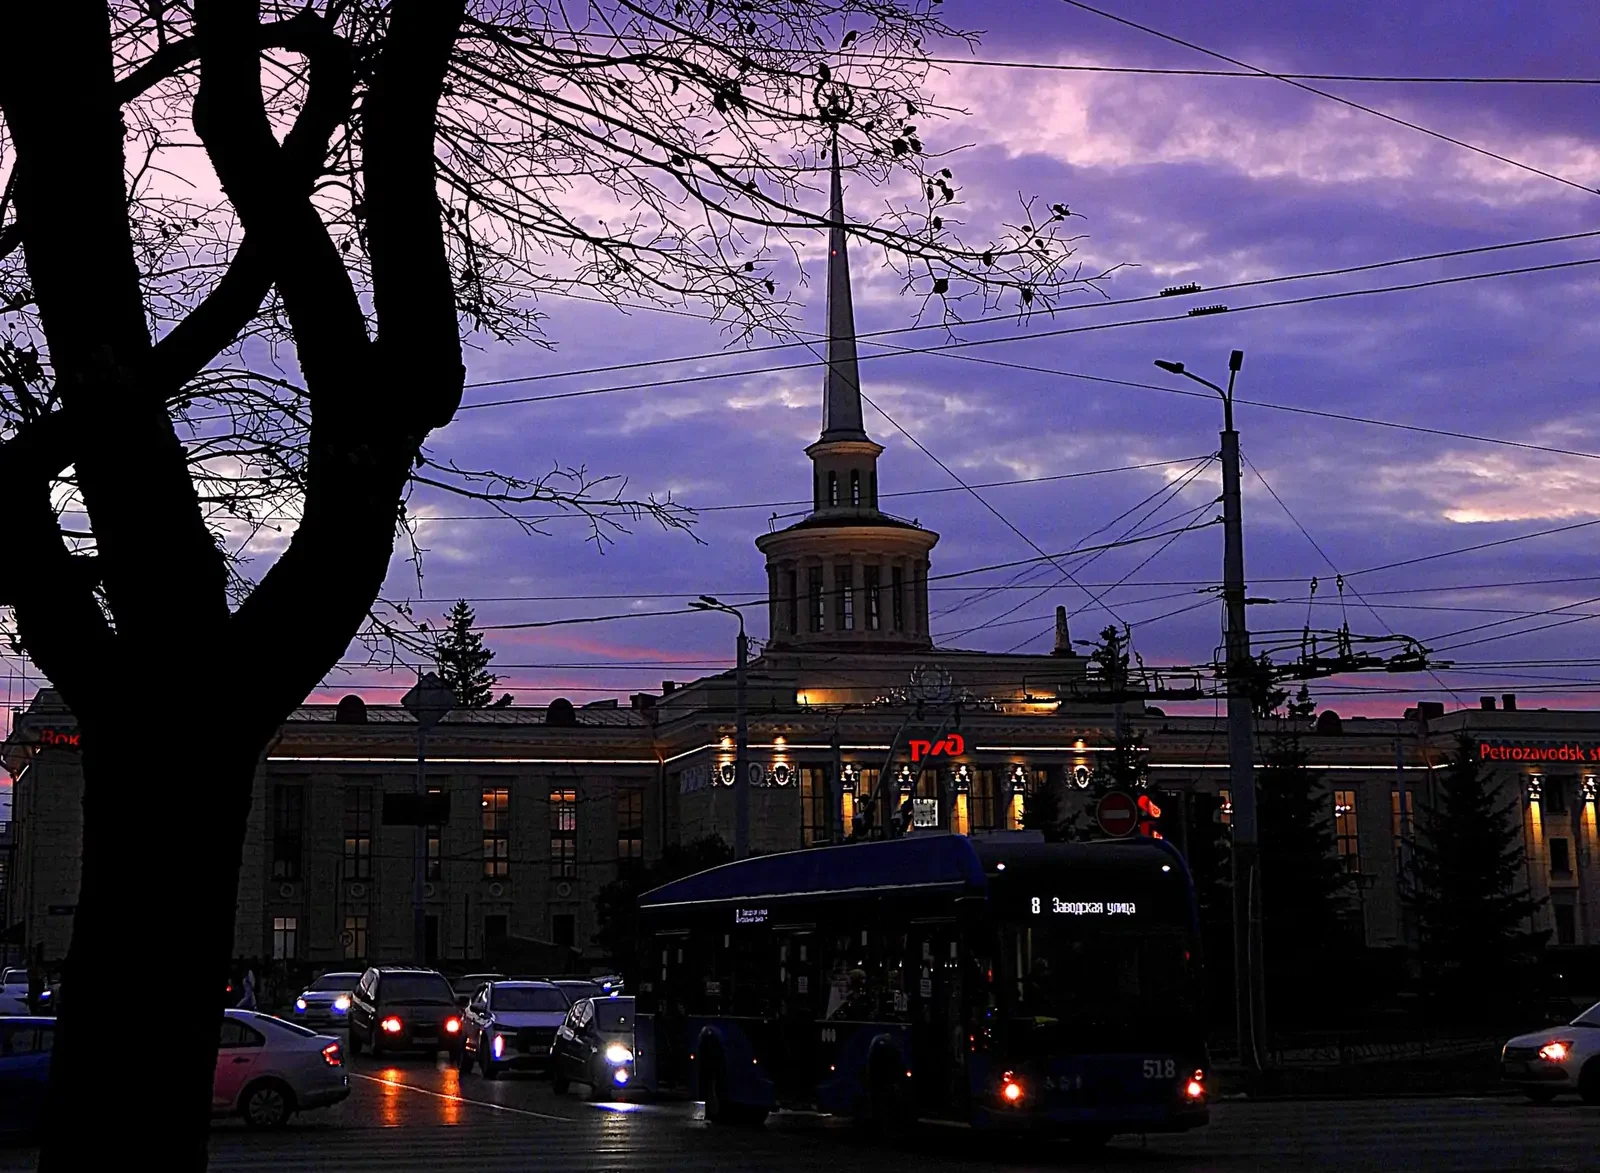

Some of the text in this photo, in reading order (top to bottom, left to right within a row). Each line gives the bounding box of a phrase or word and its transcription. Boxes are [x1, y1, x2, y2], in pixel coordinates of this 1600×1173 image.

[1480, 743, 1585, 761] Petrozavodsk
[1031, 897, 1136, 915] 8 Заводская улица
[1143, 1059, 1177, 1079] 518
